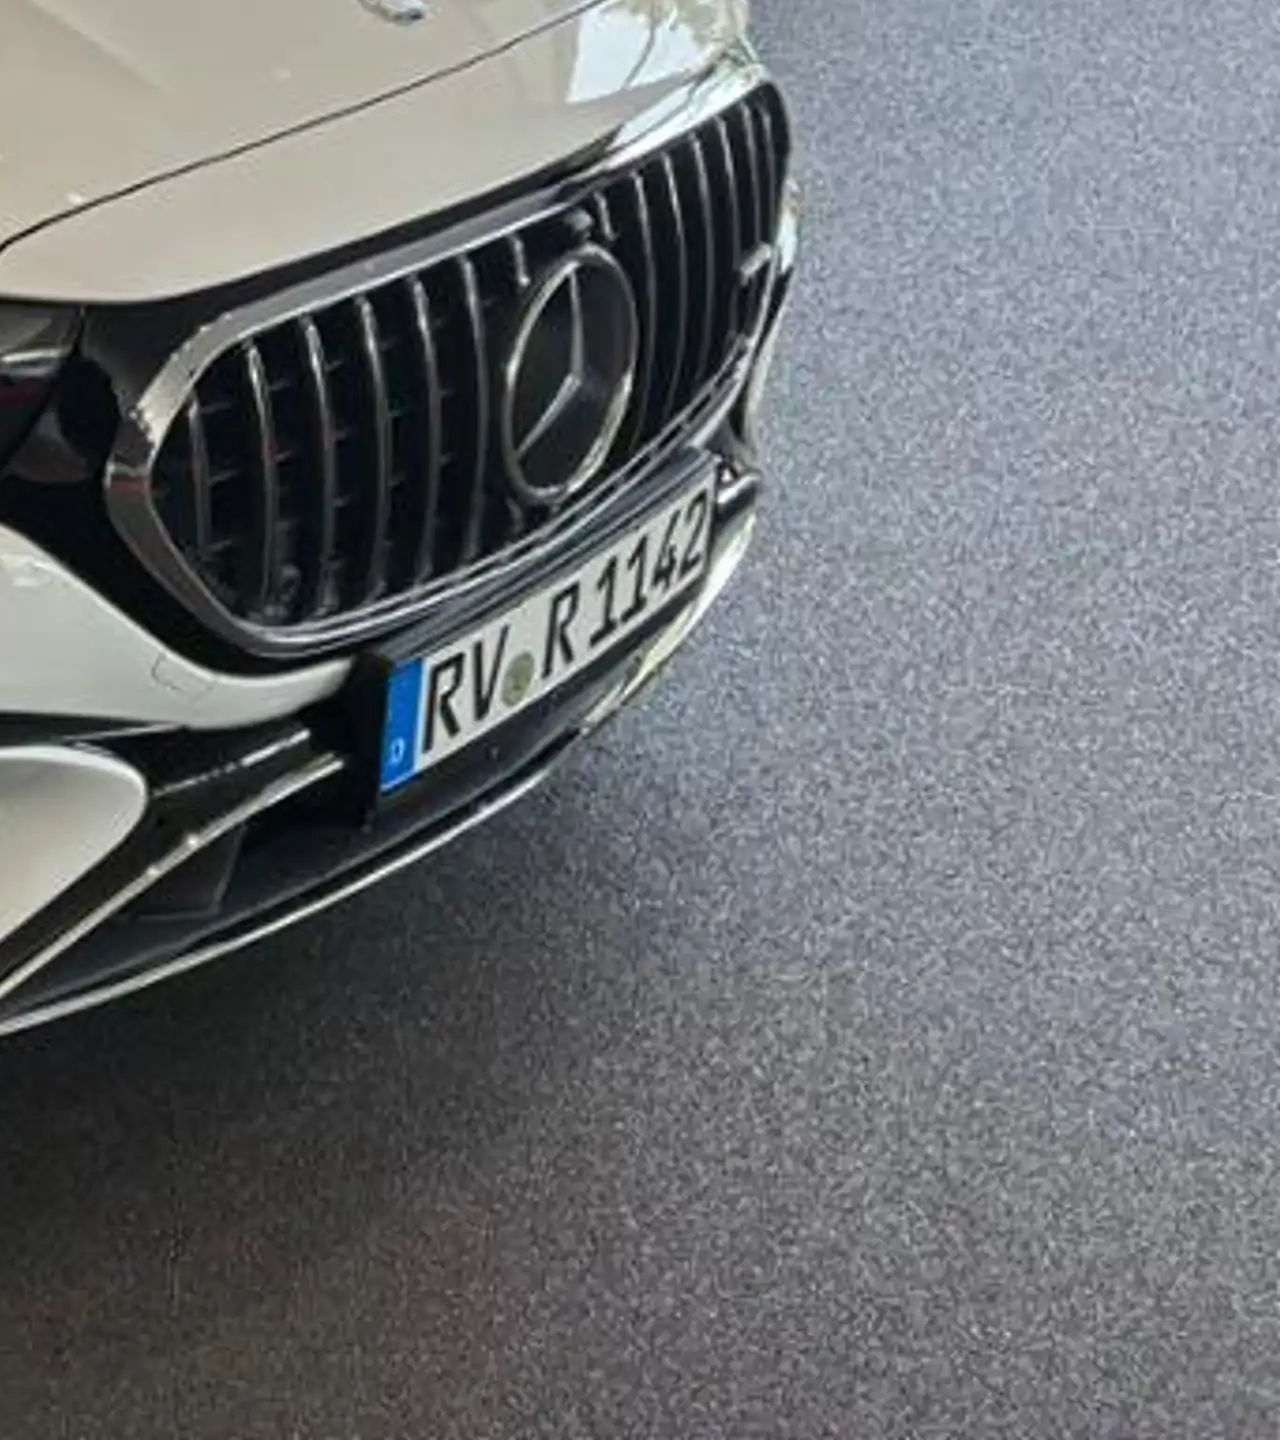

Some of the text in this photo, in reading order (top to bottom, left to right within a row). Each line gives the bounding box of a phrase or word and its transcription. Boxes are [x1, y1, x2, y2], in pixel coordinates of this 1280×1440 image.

[422, 488, 707, 754] RV R 1142
